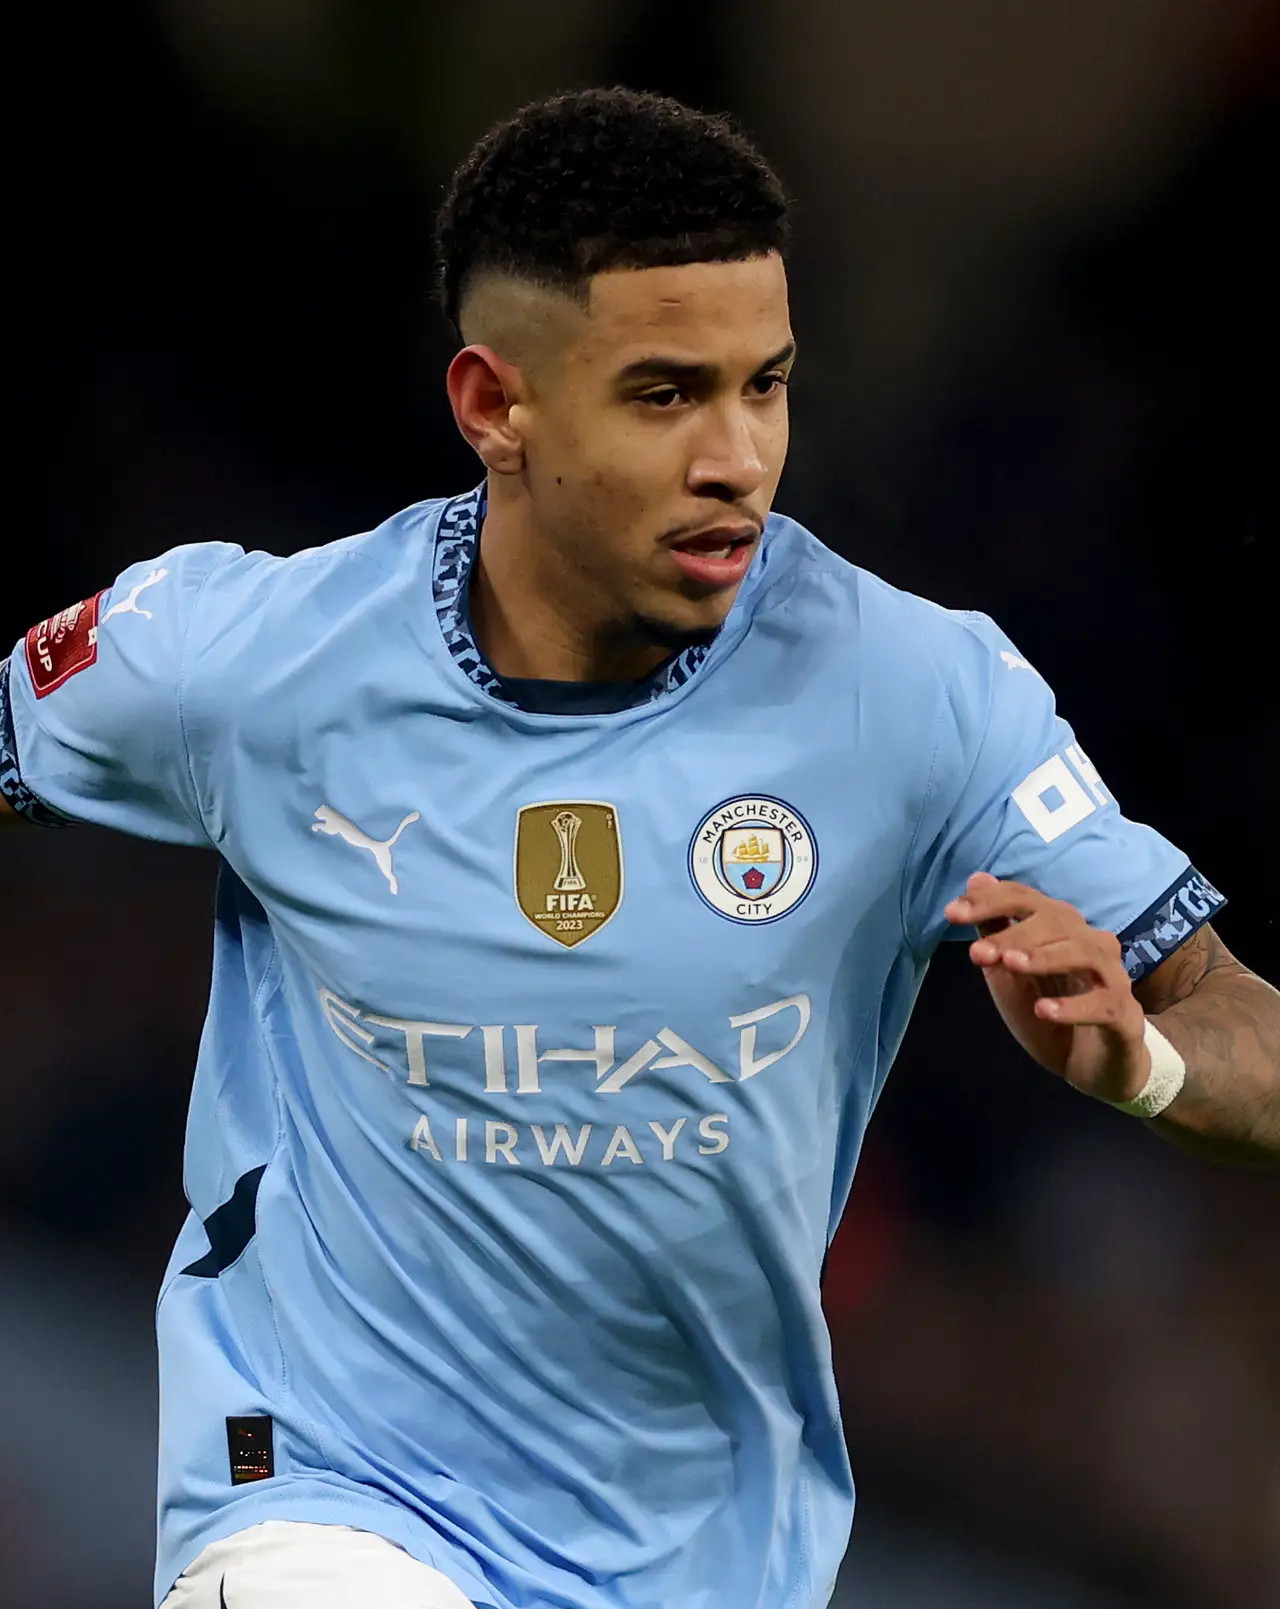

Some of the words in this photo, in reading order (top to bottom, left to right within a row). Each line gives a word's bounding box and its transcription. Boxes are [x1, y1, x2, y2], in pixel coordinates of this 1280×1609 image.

[37, 620, 53, 672] CUP
[702, 804, 803, 843] MANCHESTER
[535, 912, 561, 920] WORLD
[562, 911, 606, 919] CHAMPIONS
[546, 893, 594, 911] FIFA
[736, 903, 773, 915] CITY
[556, 920, 583, 930] 2023
[320, 988, 812, 1094] ETIHAD
[410, 1113, 730, 1166] AIRWAYS
